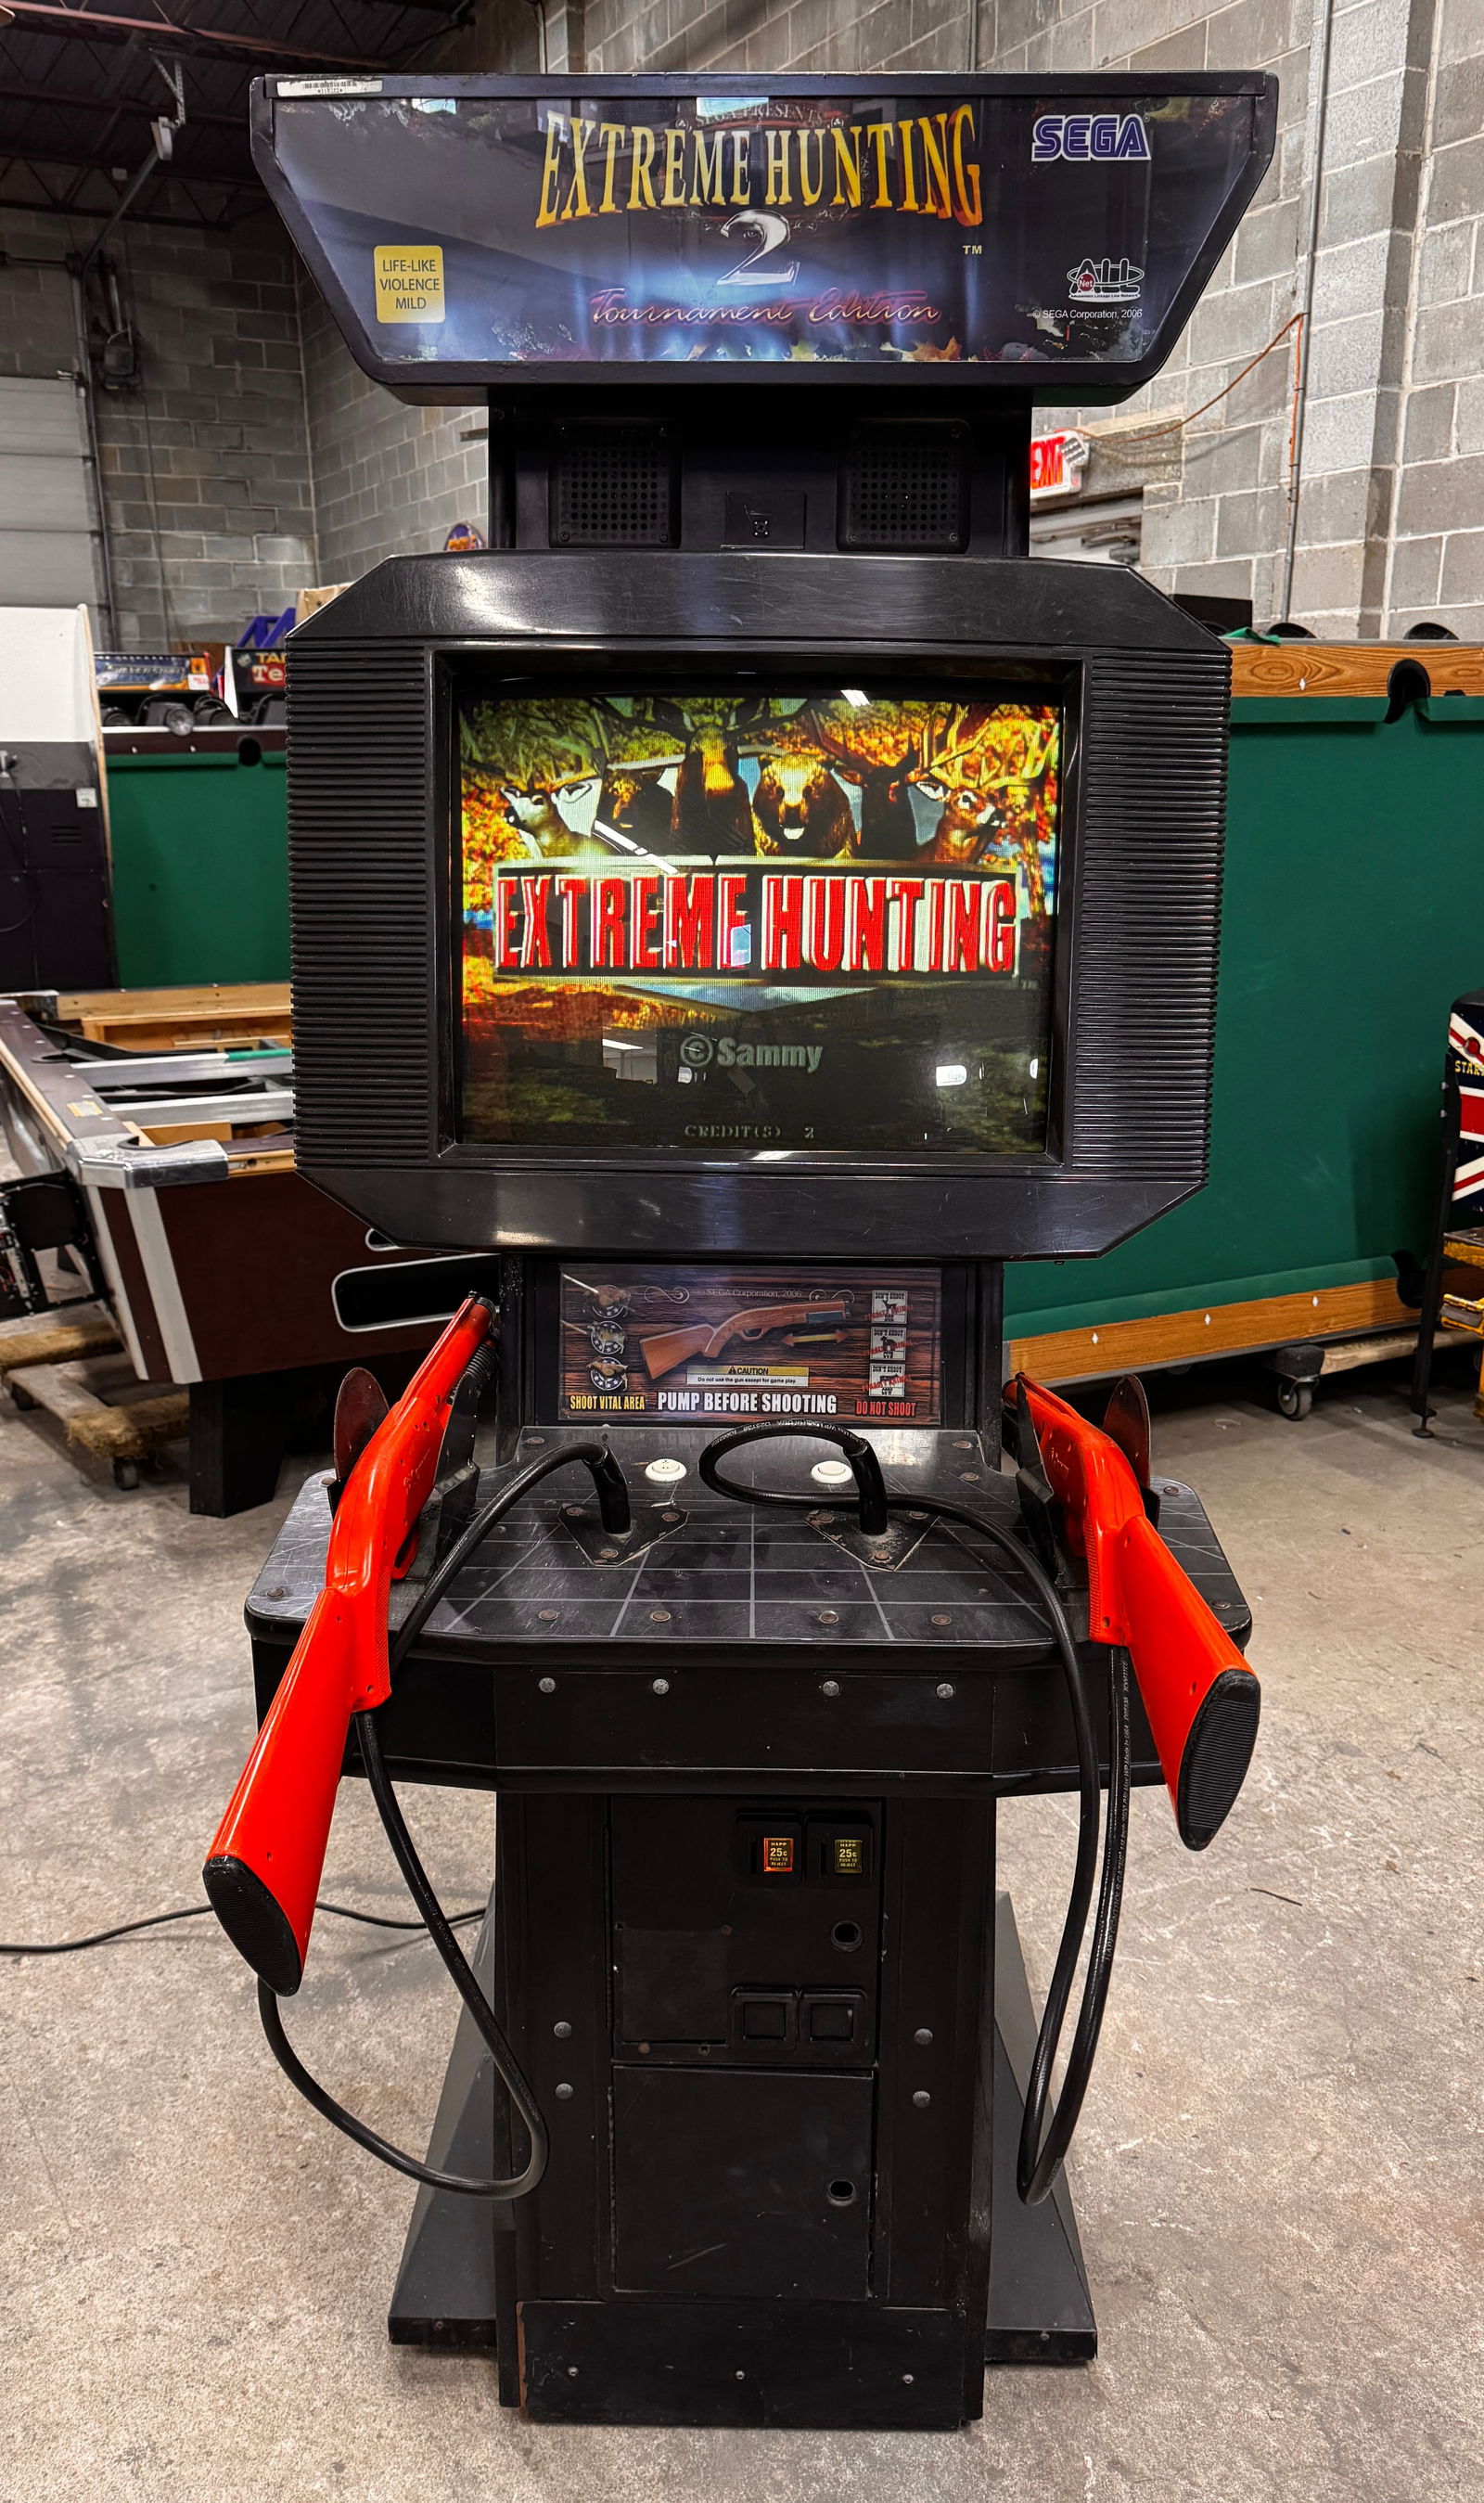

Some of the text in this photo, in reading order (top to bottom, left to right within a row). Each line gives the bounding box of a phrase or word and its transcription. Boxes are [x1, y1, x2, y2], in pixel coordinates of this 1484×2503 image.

[743, 101, 824, 125] PRESENTS
[1031, 114, 1151, 161] SEGA
[535, 104, 983, 228] EXTREME HUNTING
[717, 209, 800, 287] 2
[963, 245, 982, 254] TM
[382, 259, 437, 273] LIFE-LIKE
[379, 278, 441, 291] VIOLENCE
[395, 297, 427, 310] MILD
[591, 287, 941, 326] Tournament Edition
[1043, 310, 1068, 318] SEGA
[1069, 310, 1119, 320] Corporation,
[1121, 309, 1143, 318] 2006
[495, 873, 1018, 973] EXTREME HUNTING
[717, 1037, 824, 1073] Sammy
[1454, 1059, 1484, 1076] STAR
[684, 1124, 781, 1138] CREDIT(S)
[570, 1395, 645, 1410] SHOOT VITAL AREA
[658, 1393, 837, 1414] PUMP BEFORE SHOOTING
[855, 1401, 916, 1416] DO NOT SHOOT
